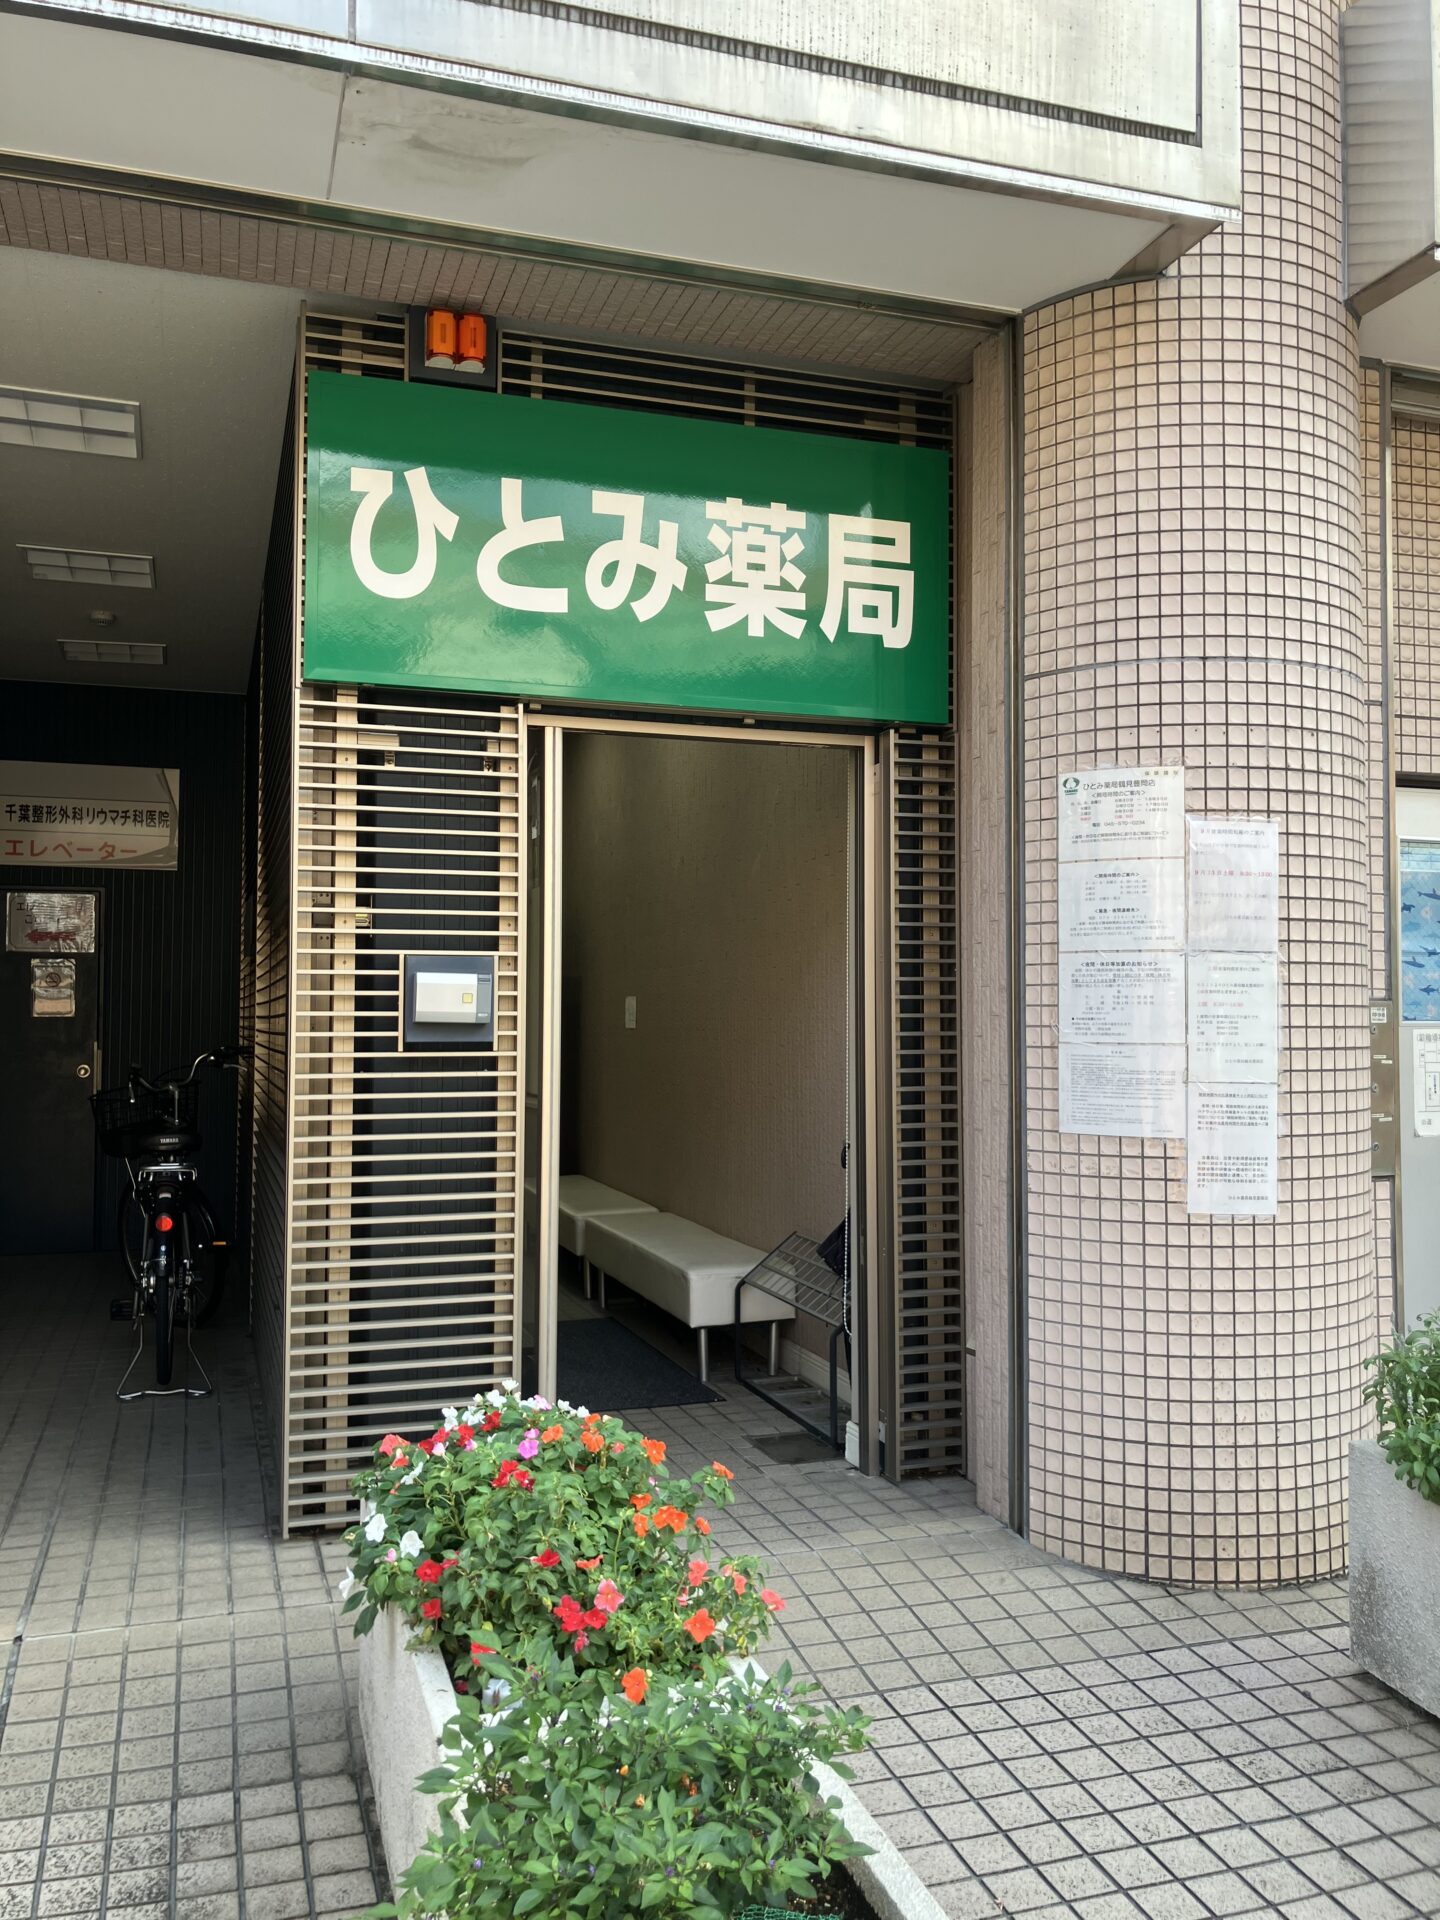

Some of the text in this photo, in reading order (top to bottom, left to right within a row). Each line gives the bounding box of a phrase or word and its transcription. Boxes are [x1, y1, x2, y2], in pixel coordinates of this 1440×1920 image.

[349, 466, 914, 649] ひとみ薬局
[5, 804, 170, 828] 千葉整形外科リウマチ科医院
[5, 840, 137, 860] エレベーター
